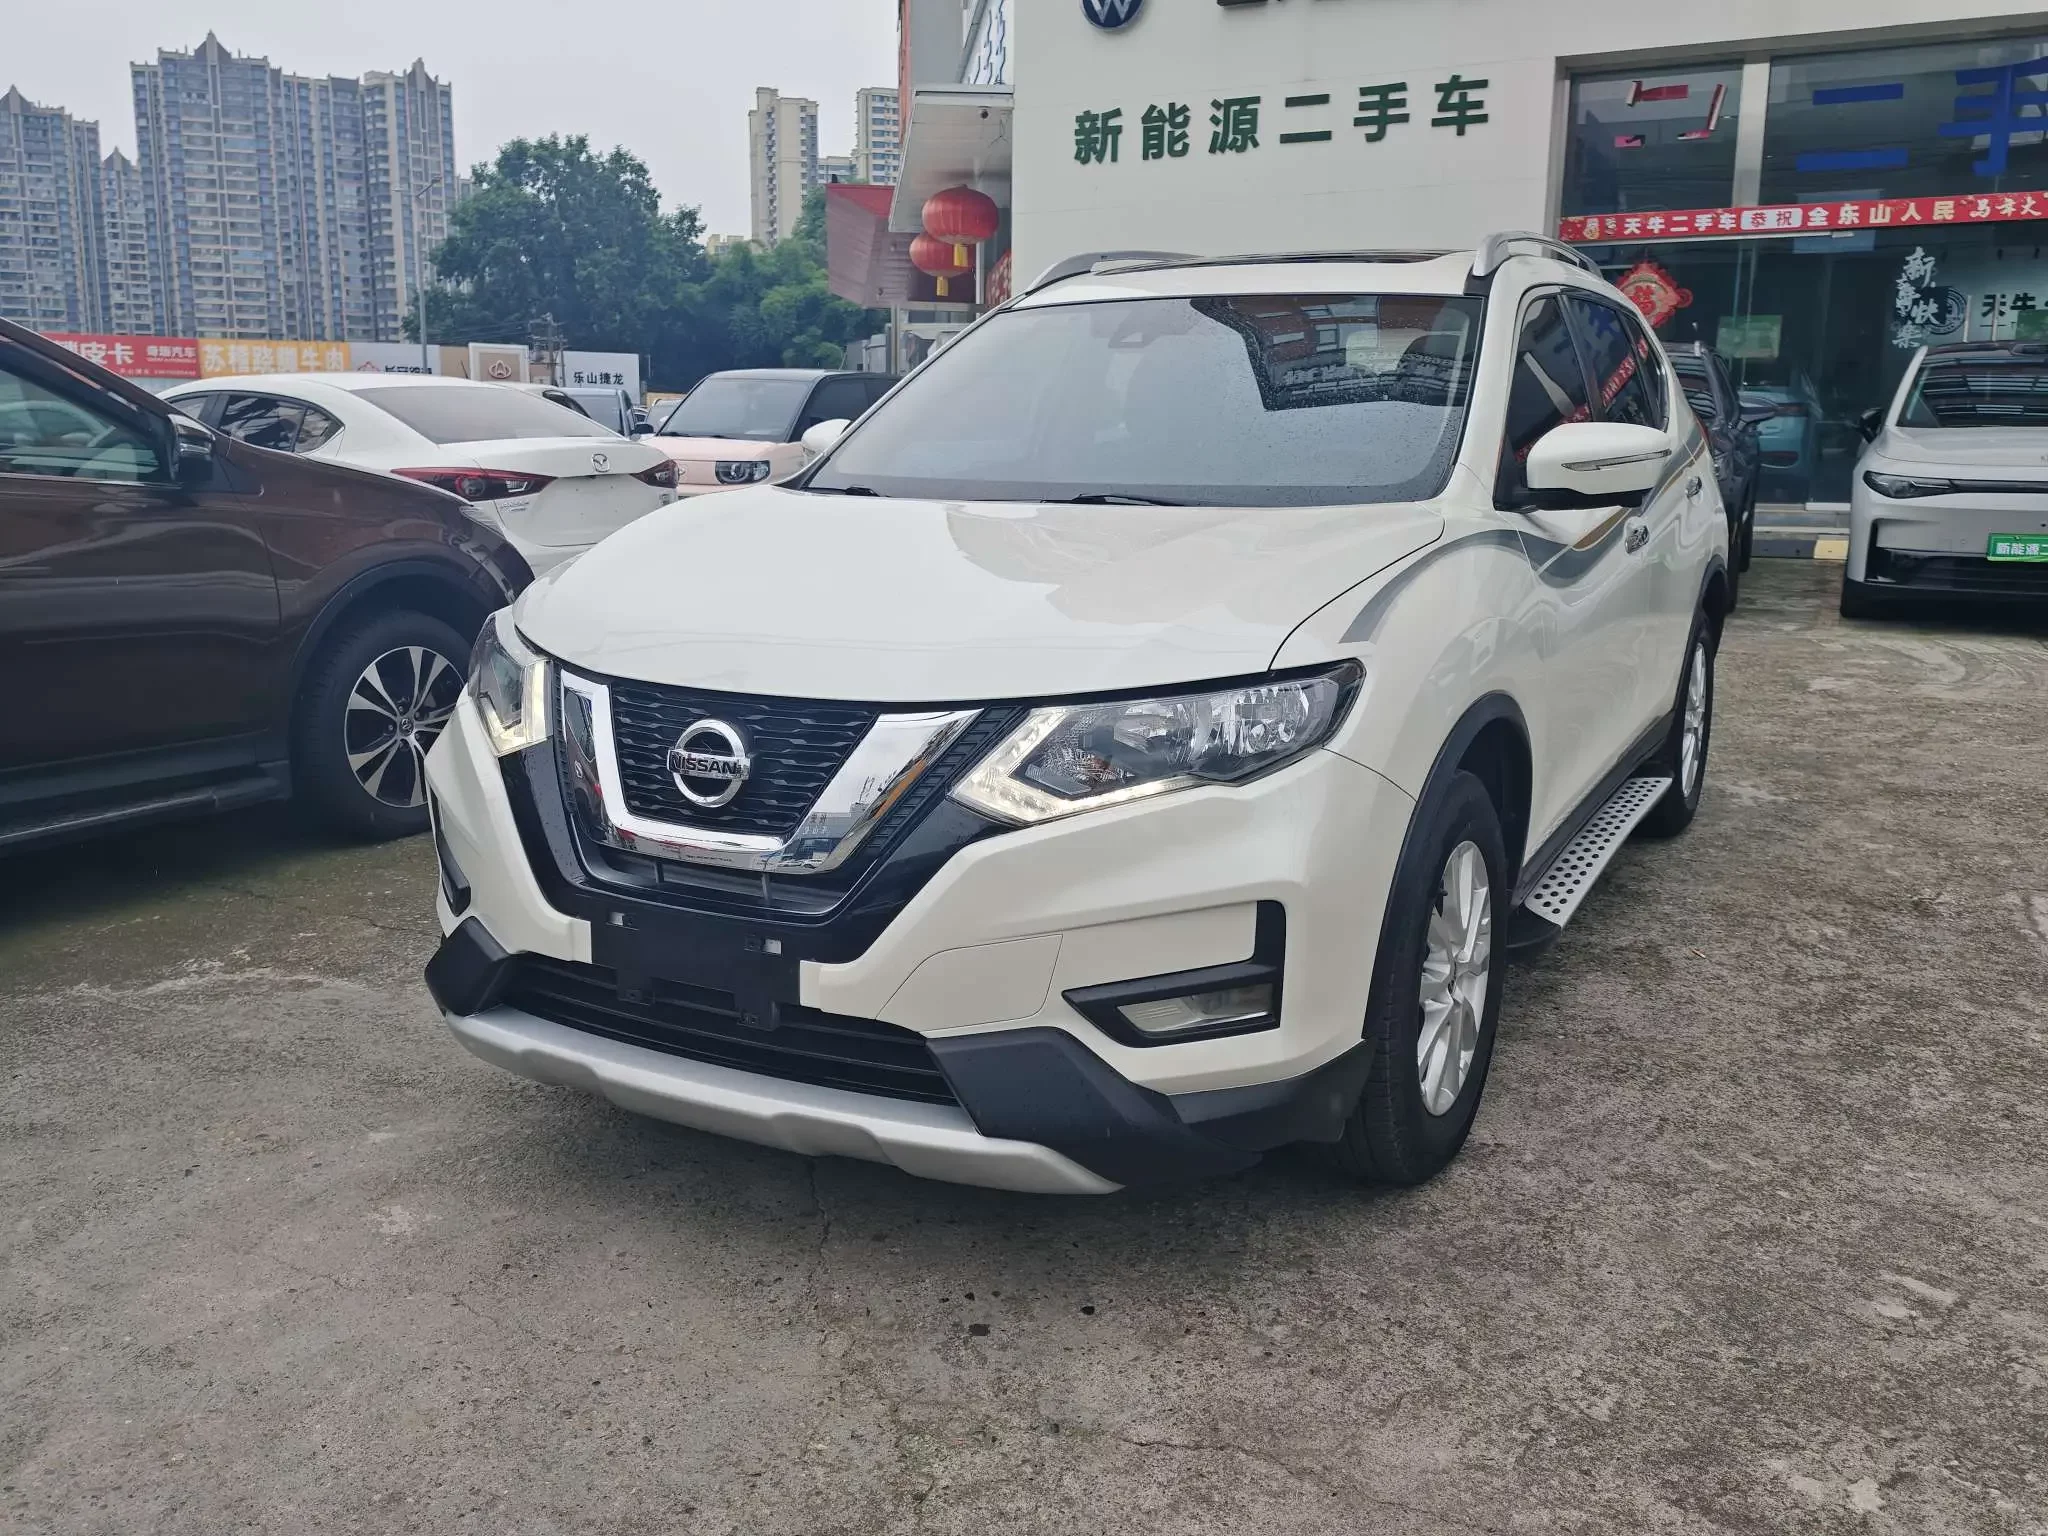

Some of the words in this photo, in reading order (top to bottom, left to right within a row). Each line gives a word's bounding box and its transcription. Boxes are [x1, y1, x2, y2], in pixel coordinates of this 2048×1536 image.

[1073, 74, 1490, 165] 新能源二手车
[573, 371, 624, 386] 乐山捷龙
[669, 749, 738, 775] NISSAN
